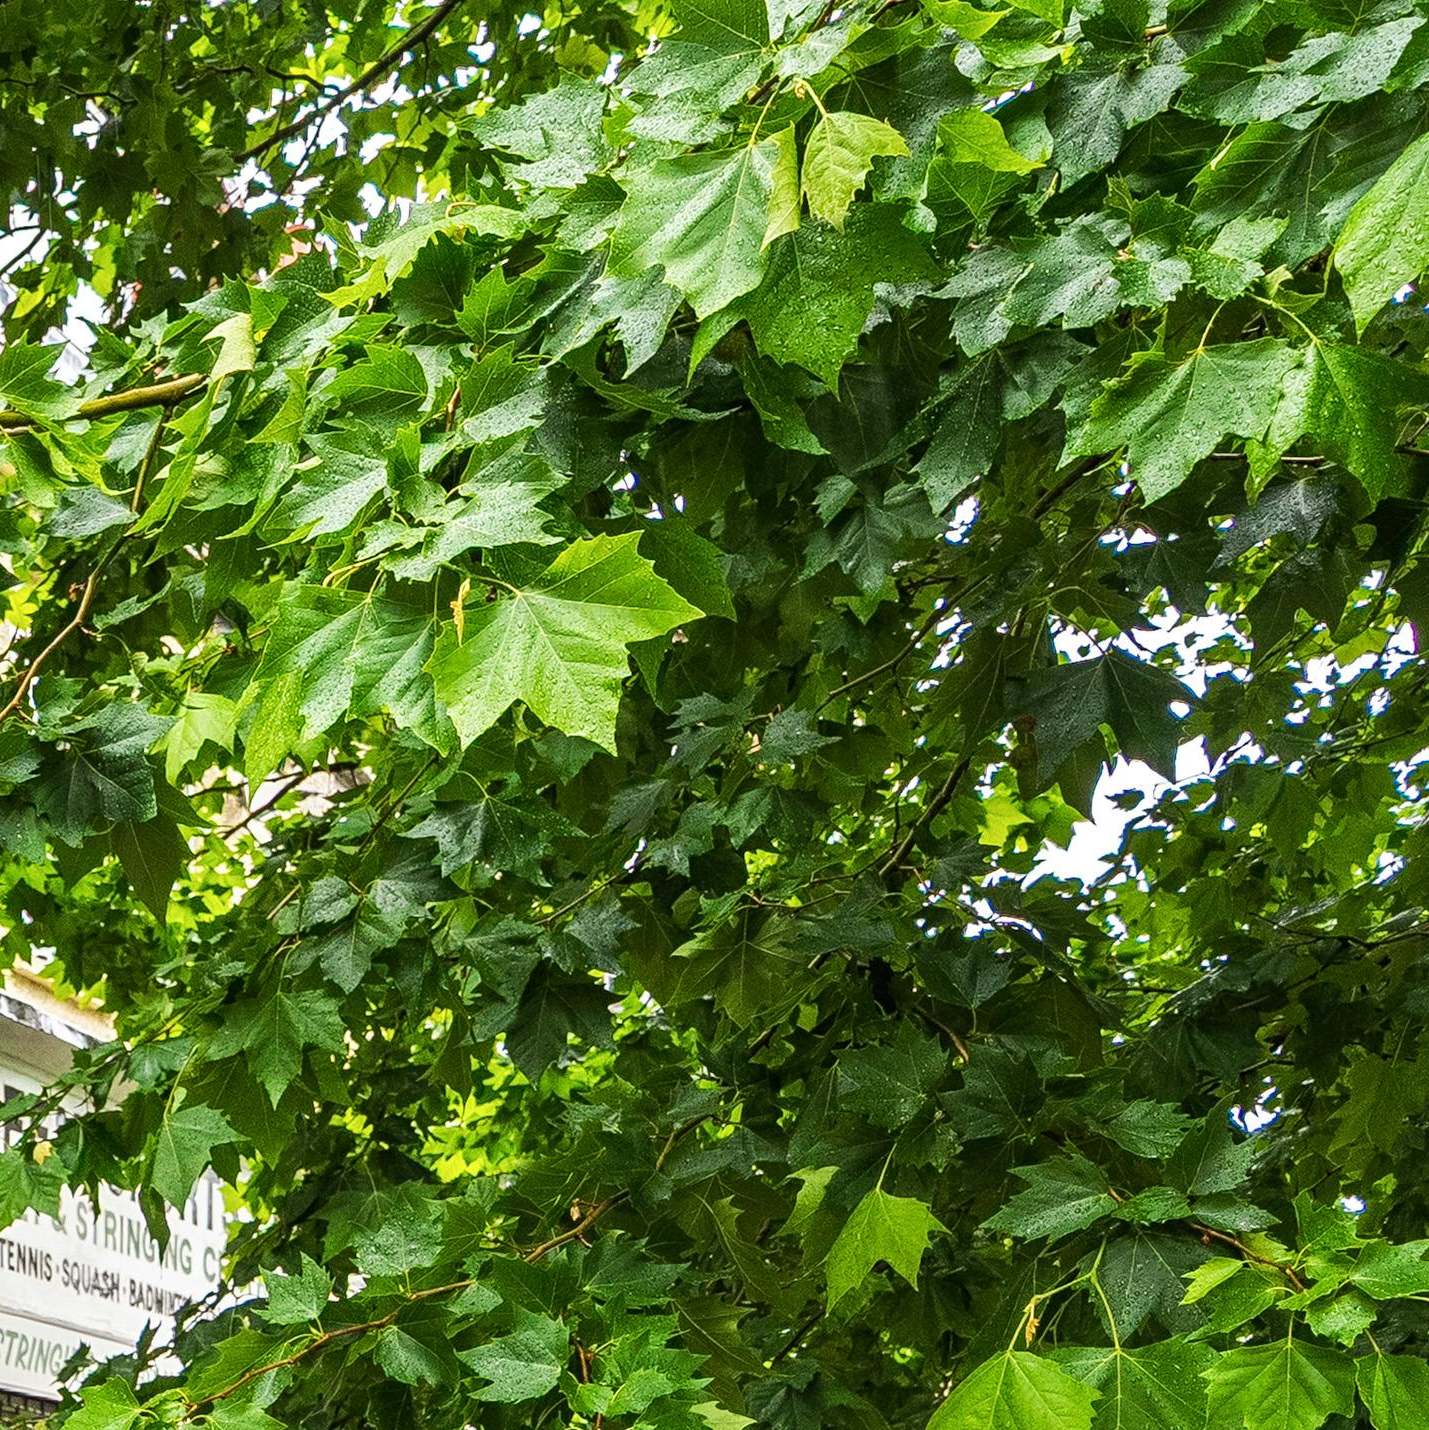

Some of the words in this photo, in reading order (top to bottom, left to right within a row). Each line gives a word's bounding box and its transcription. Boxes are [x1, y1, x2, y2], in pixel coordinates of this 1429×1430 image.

[75, 1200, 193, 1277] STRINGNG
[61, 1257, 121, 1302] SQUASH
[129, 1277, 188, 1317] BADMINT
